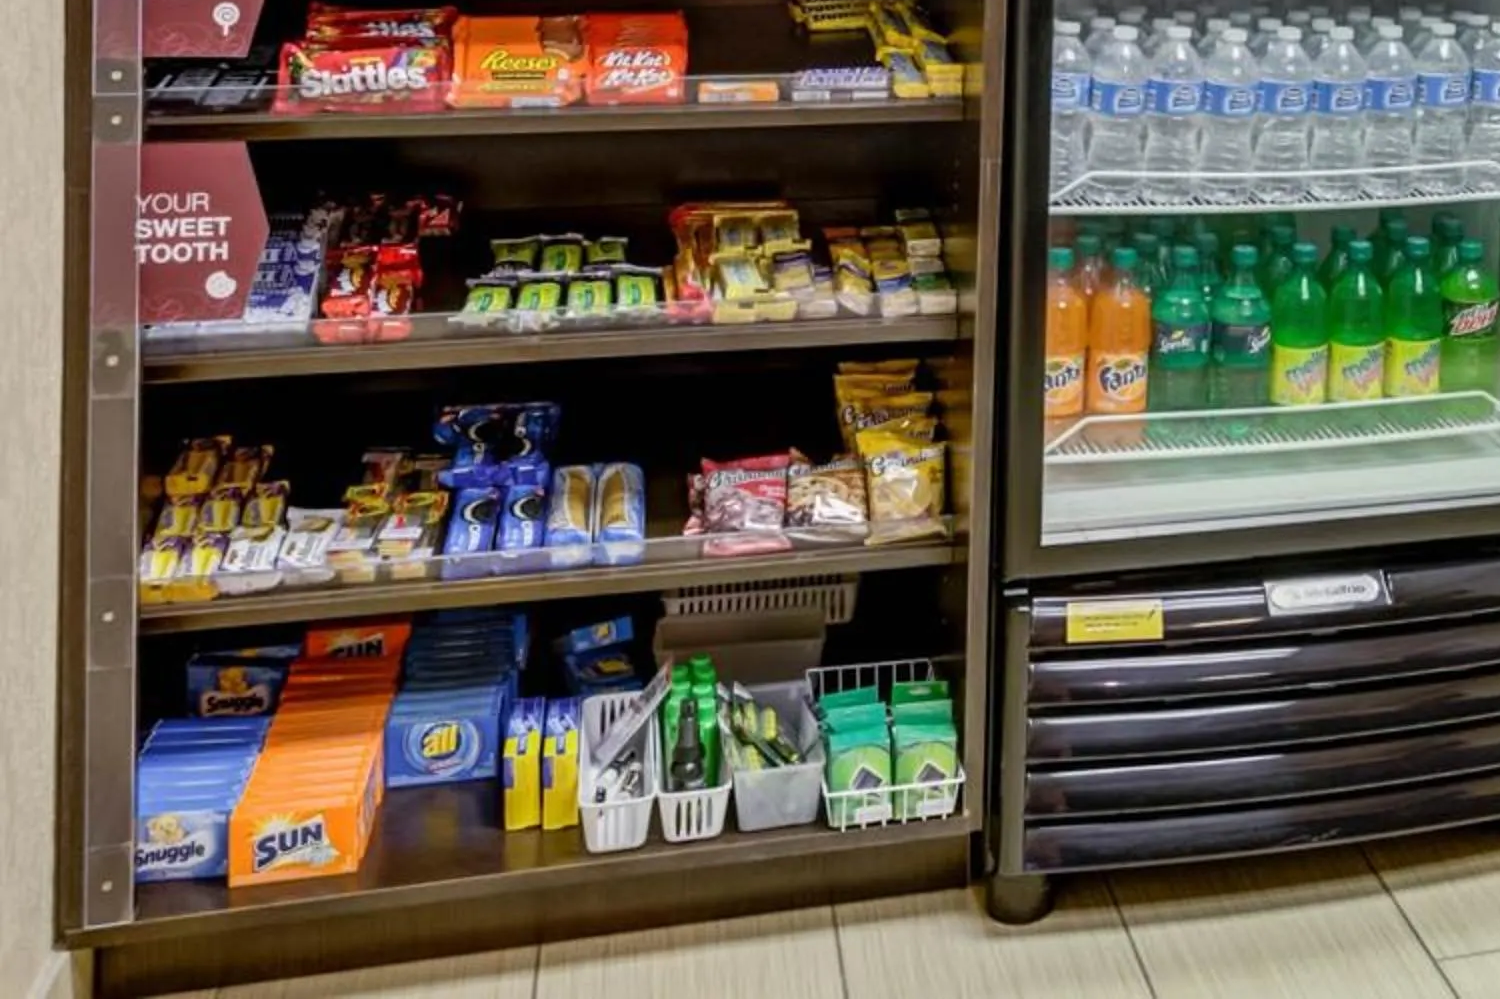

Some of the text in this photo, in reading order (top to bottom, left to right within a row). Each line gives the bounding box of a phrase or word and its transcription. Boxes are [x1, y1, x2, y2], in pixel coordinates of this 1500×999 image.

[300, 59, 427, 98] Skittles
[135, 192, 209, 212] YOUR
[134, 217, 231, 238] SWEET
[134, 242, 229, 264] TOOTH
[421, 723, 460, 759] all
[134, 841, 205, 868] Snuggle
[256, 823, 323, 868] SUN
